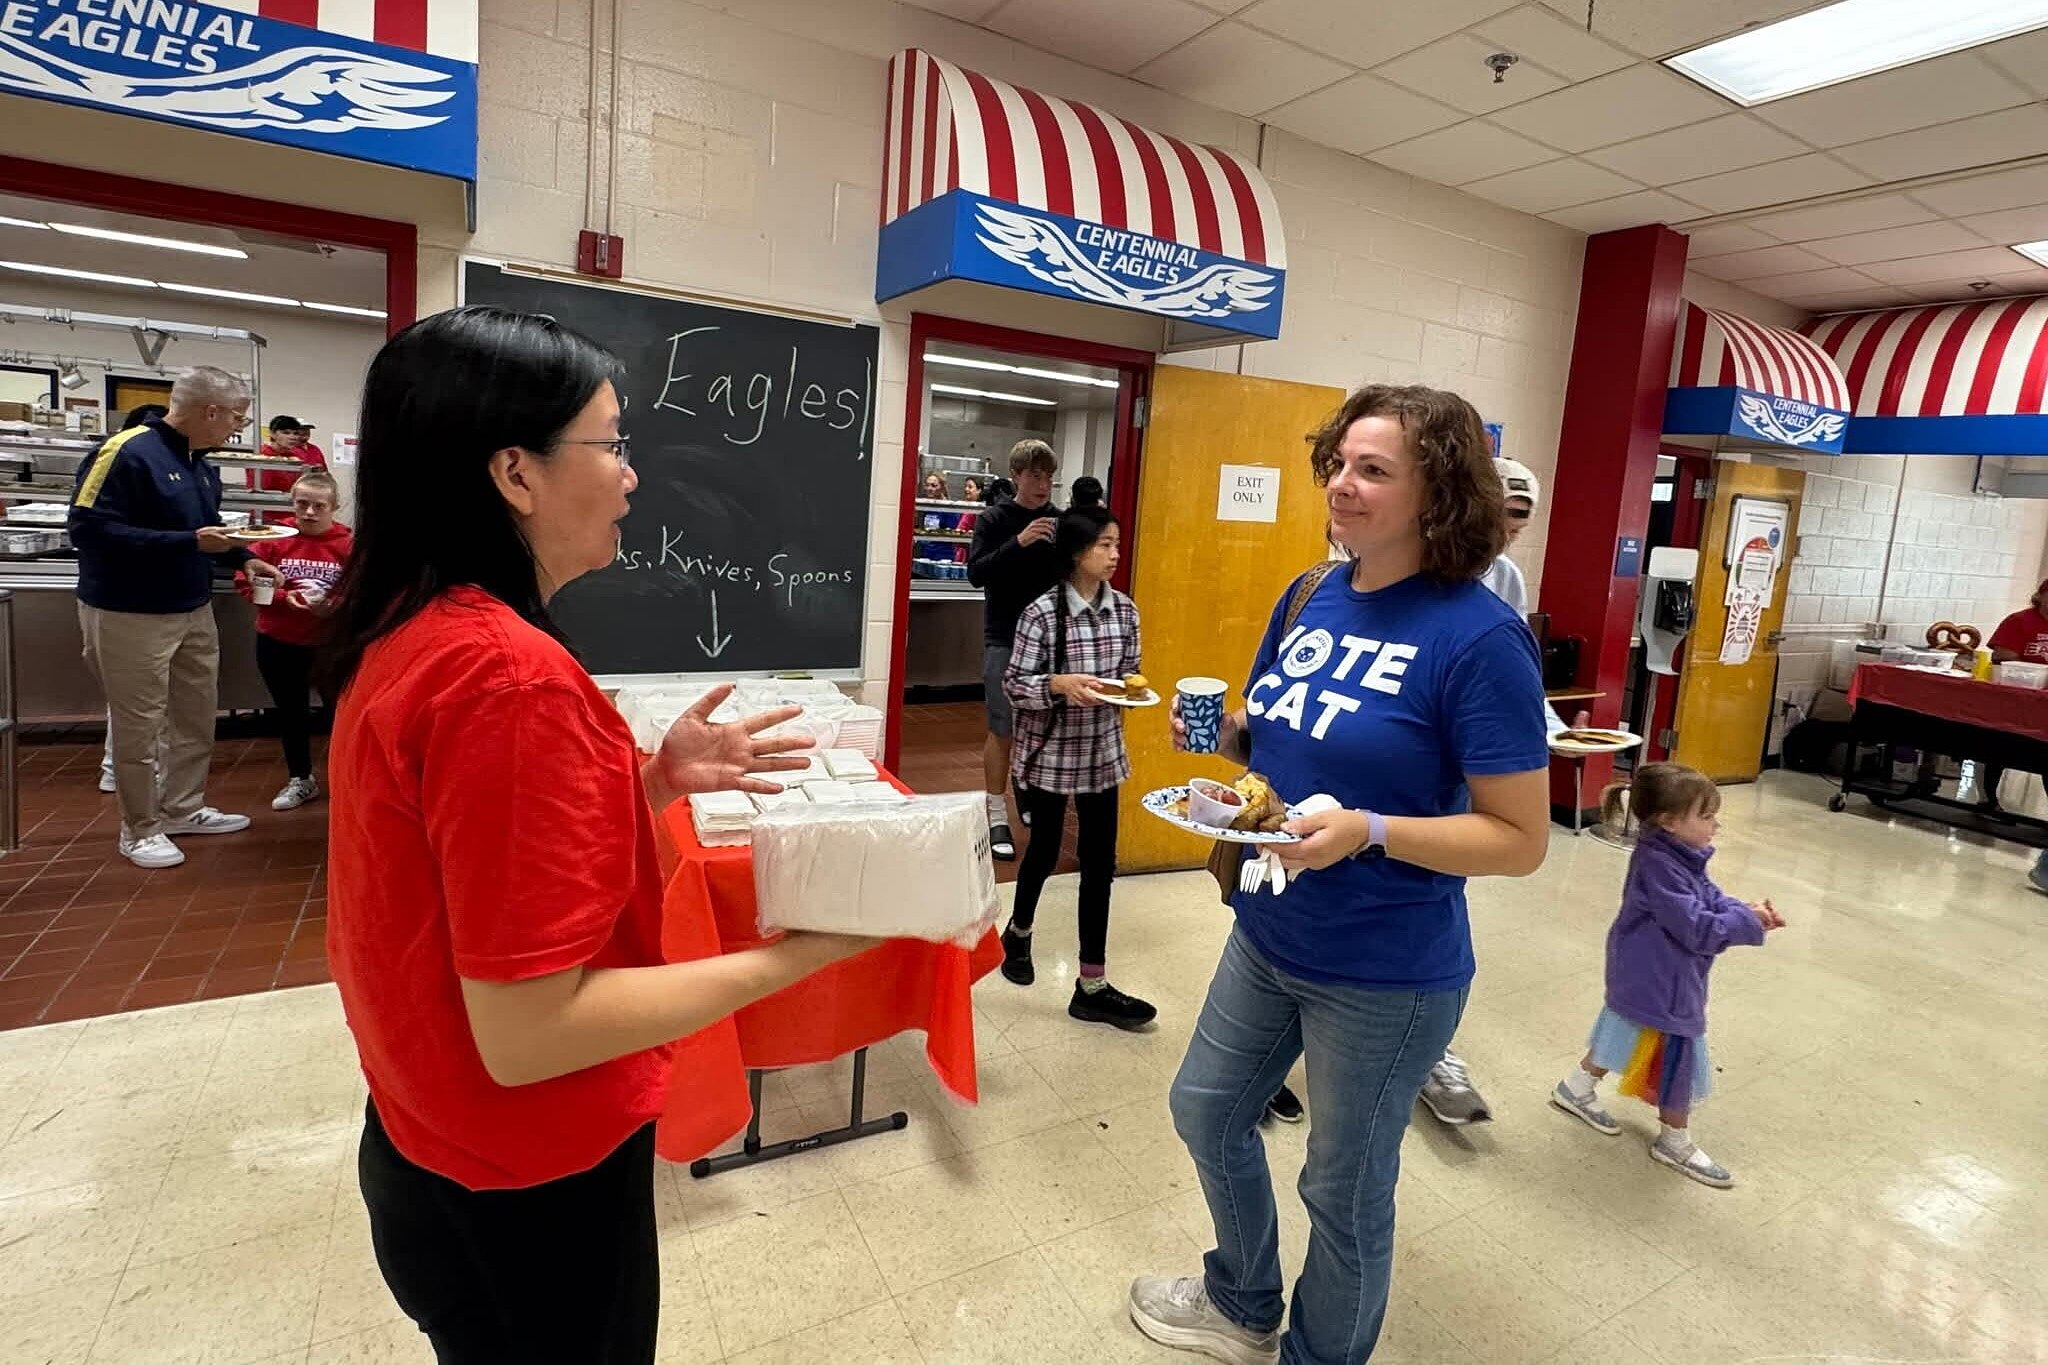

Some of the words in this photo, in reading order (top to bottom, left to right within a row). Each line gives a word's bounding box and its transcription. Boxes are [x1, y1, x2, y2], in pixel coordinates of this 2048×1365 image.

[0, 2, 219, 74] EAGLES
[1075, 223, 1199, 269] CENTENNIAL
[1097, 250, 1180, 284] EAGLES
[652, 326, 872, 461] Eagles!
[1773, 398, 1817, 418] CENTENNIAL
[1778, 411, 1810, 429] EAGLES
[1233, 491, 1265, 503] ONLY
[1237, 476, 1264, 488] EXIT
[616, 533, 652, 570] ks,
[660, 525, 761, 591] Knives,
[767, 553, 855, 607] Spoons
[1246, 673, 1362, 741] CAT
